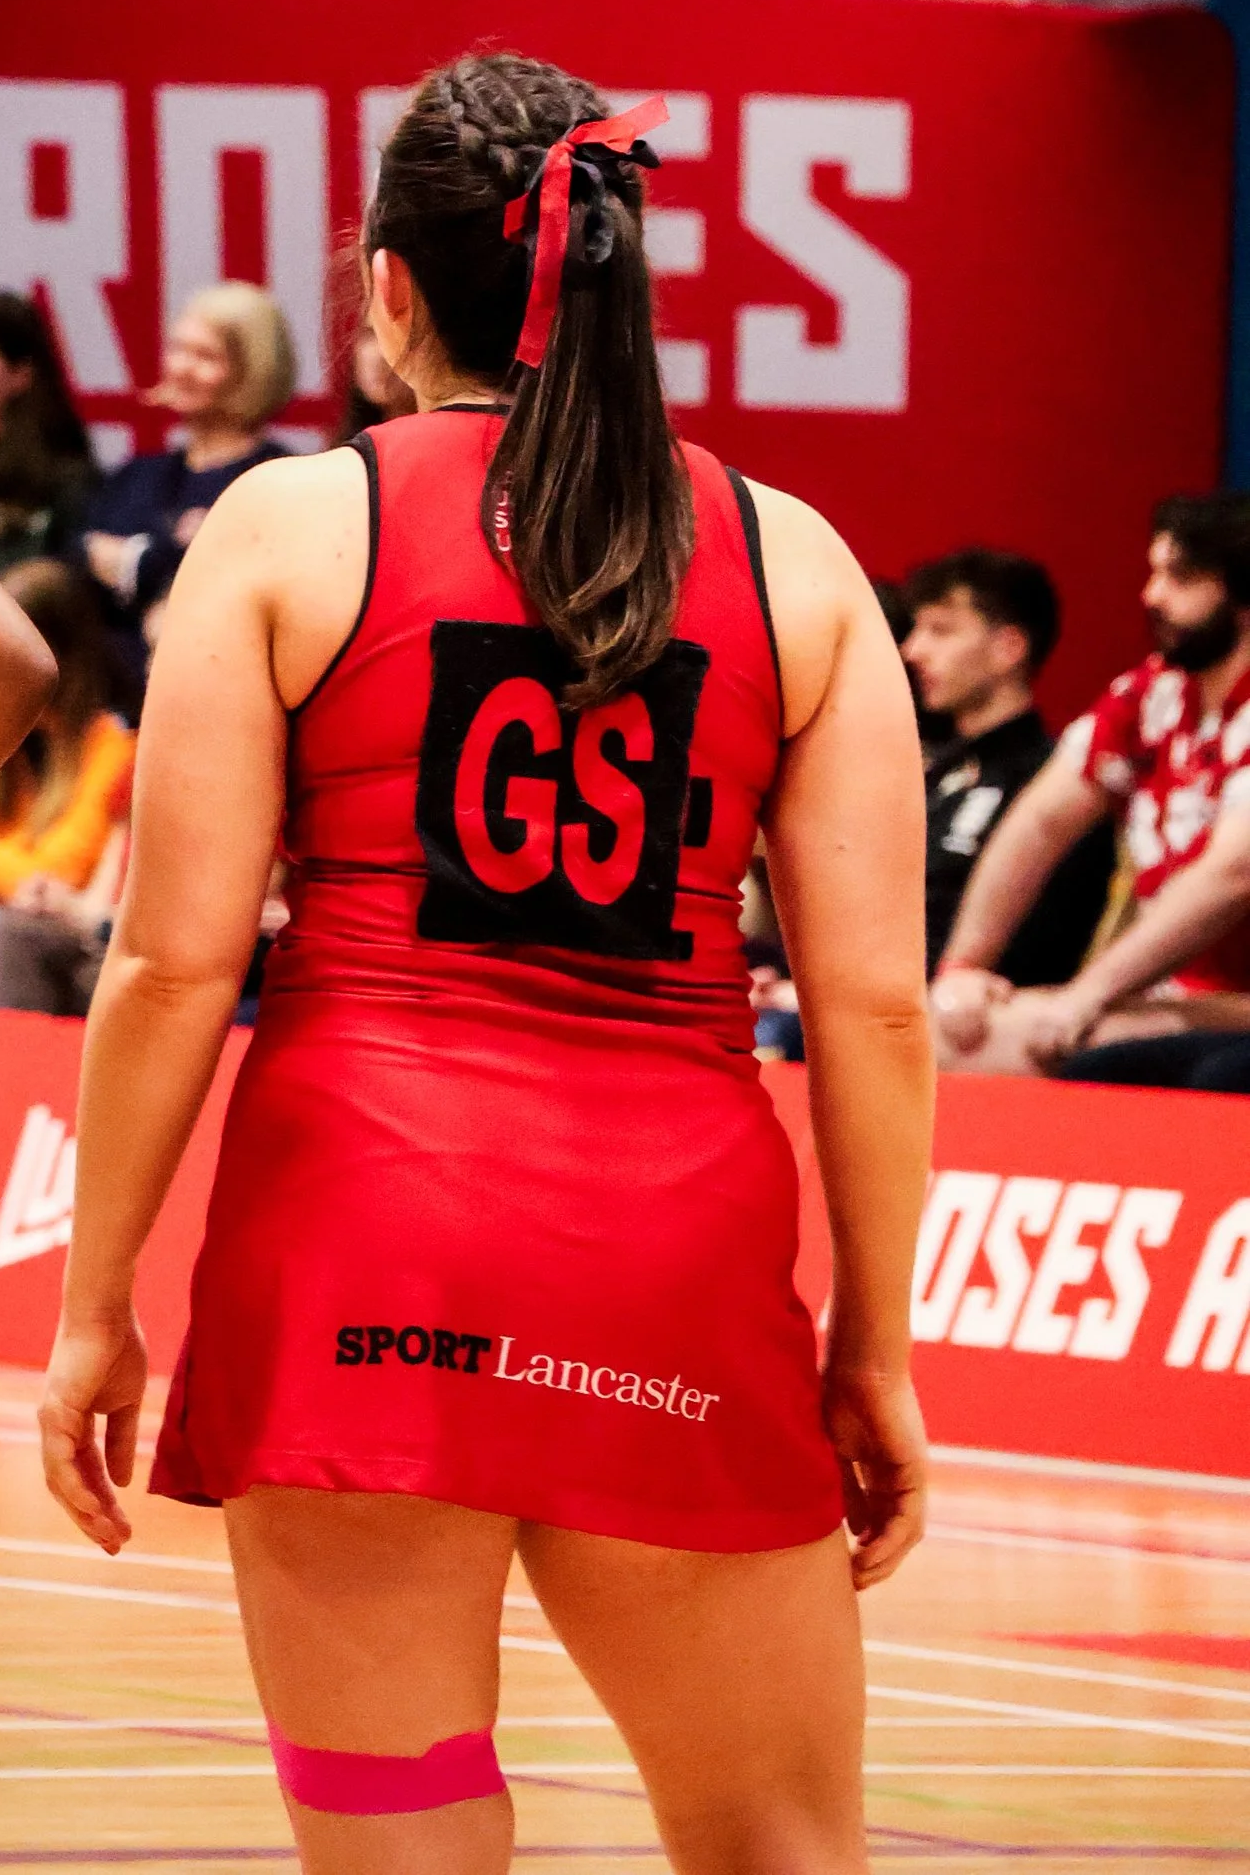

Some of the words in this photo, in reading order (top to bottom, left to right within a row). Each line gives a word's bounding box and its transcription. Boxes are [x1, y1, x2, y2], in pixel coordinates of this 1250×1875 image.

[454, 677, 654, 905] GS
[908, 1169, 1184, 1362] OSES
[493, 1336, 720, 1422] Lancaster
